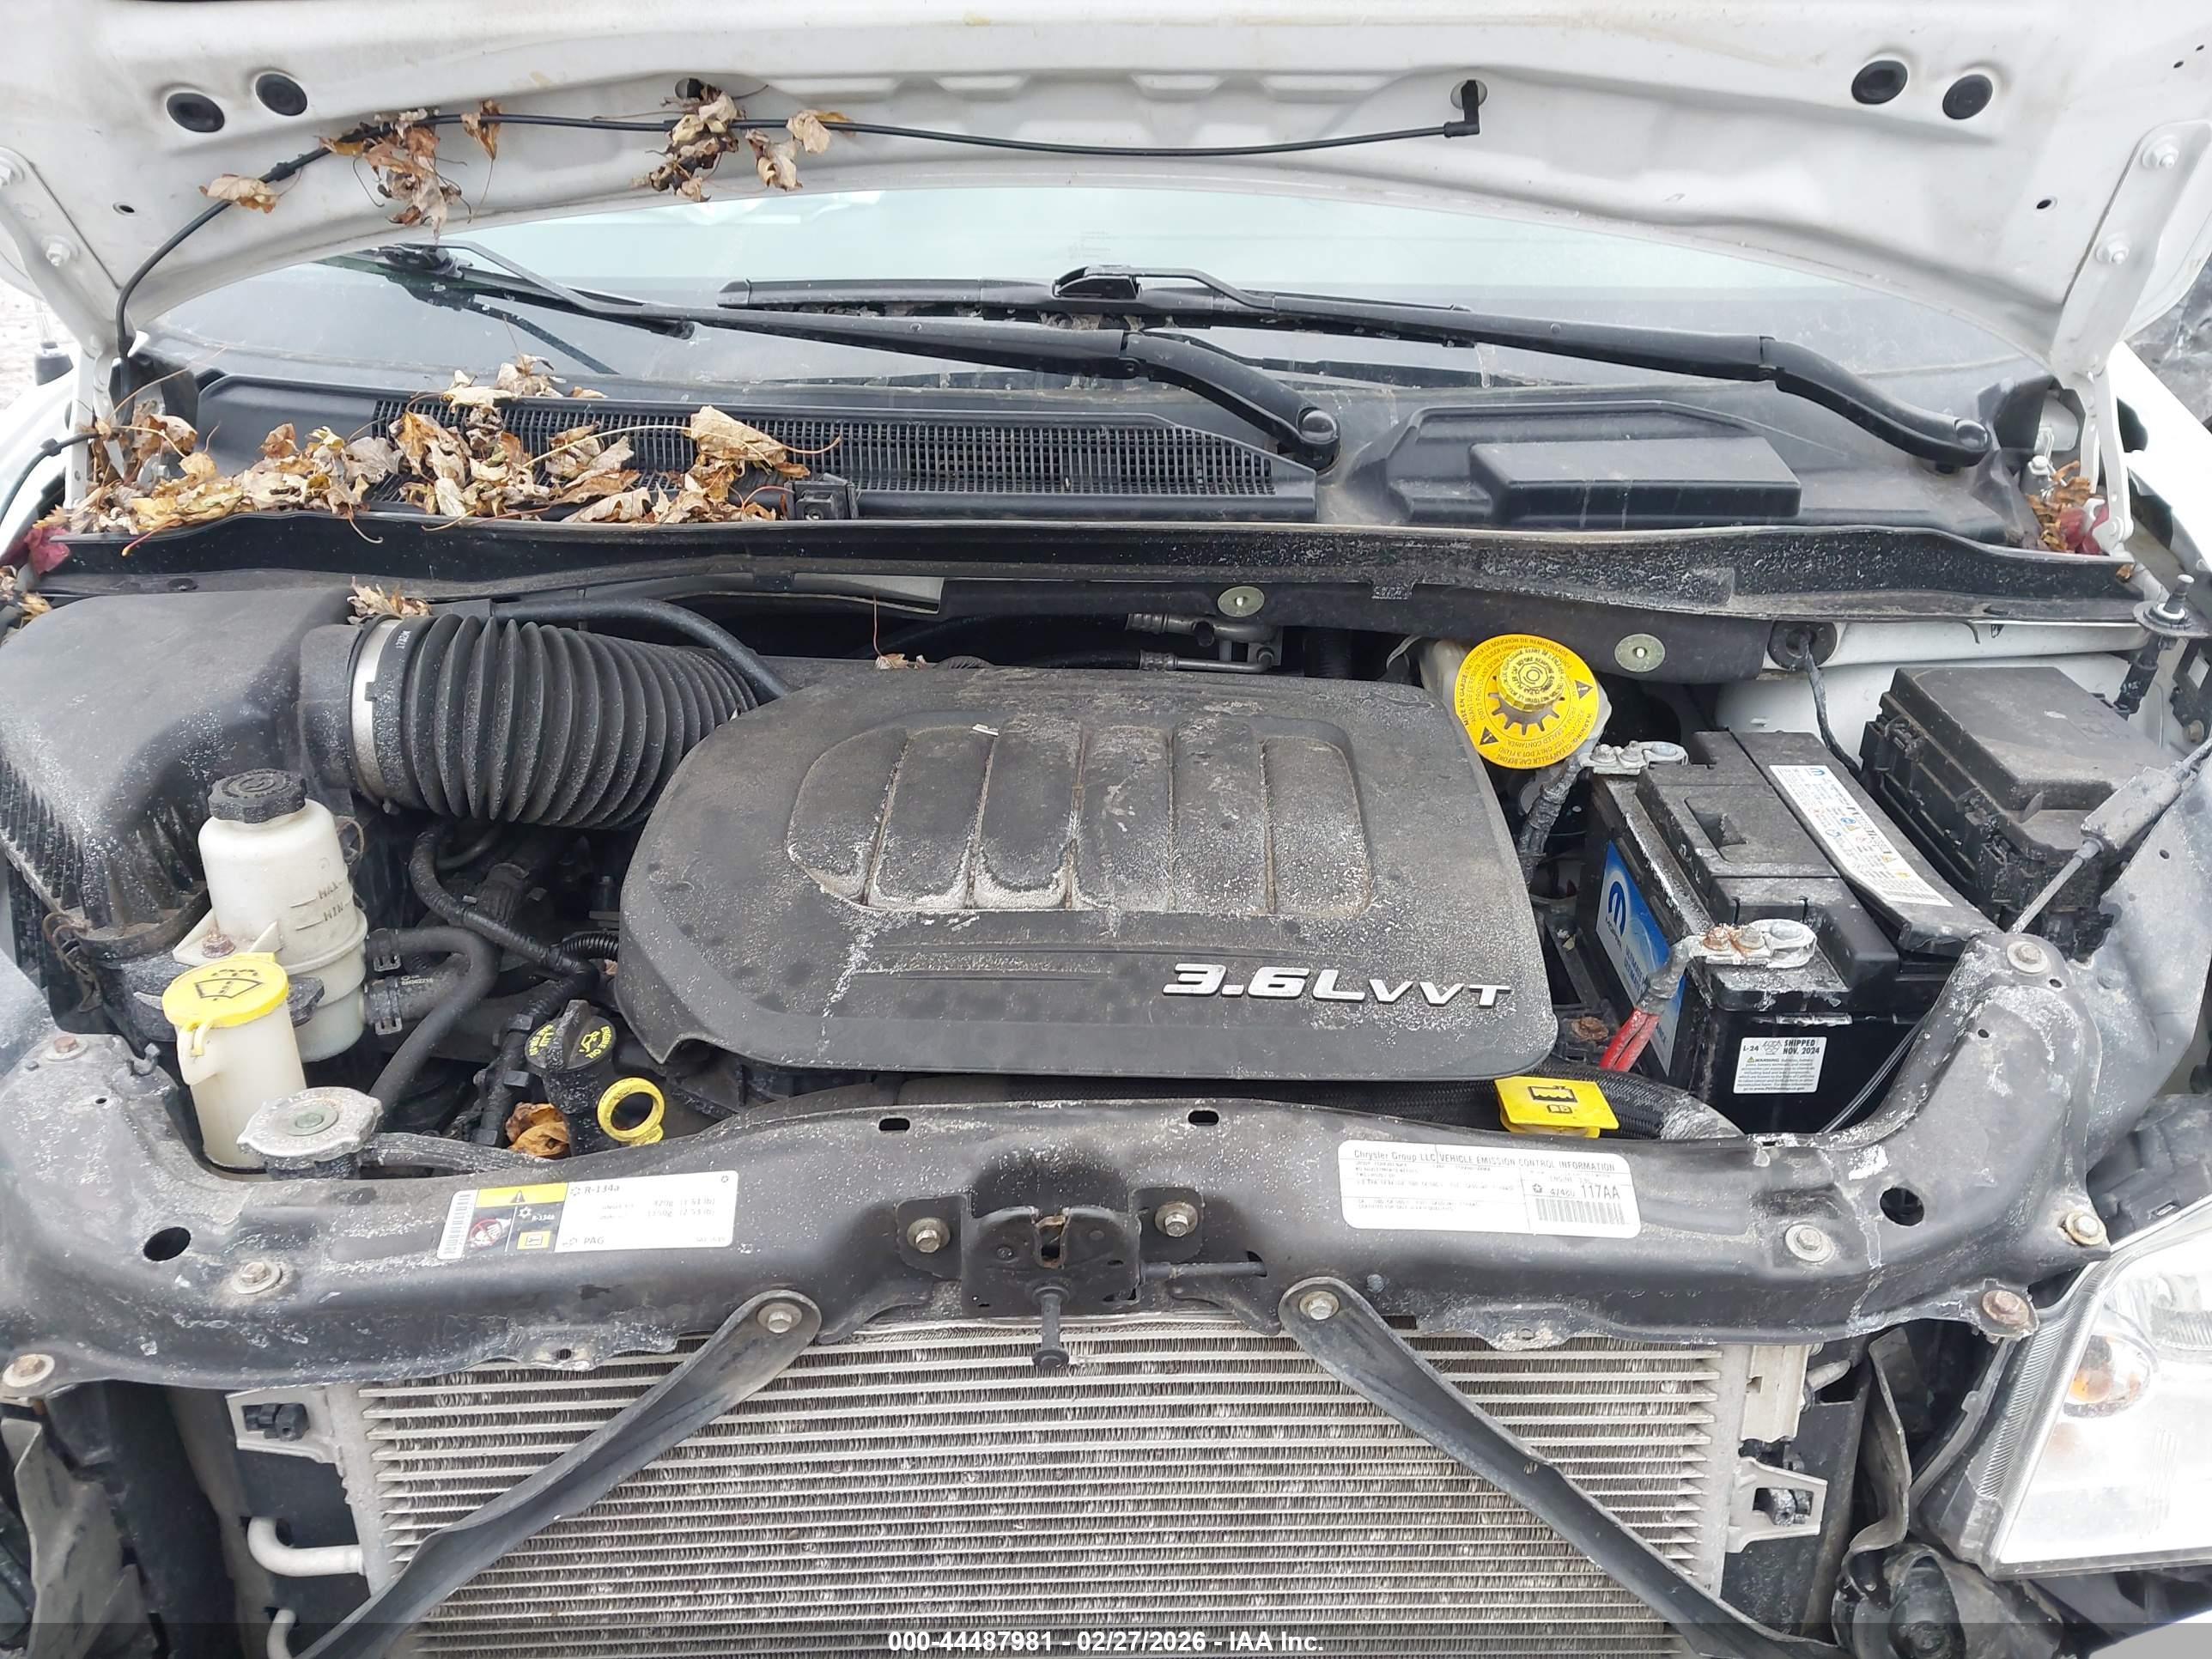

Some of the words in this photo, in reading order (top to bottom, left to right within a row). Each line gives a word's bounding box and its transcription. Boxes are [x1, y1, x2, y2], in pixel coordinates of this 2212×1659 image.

[1459, 697, 1466, 708] EN
[1459, 707, 1470, 727] MISE
[324, 902, 343, 921] MIN
[1163, 963, 1366, 1001] 3.6L
[1370, 978, 1514, 1009] VVT
[598, 1026, 612, 1049] ENGINE
[585, 1048, 602, 1059] OIL
[1782, 1047, 1799, 1055] NOV.
[1354, 1150, 1389, 1161] Chrysler
[1391, 1152, 1417, 1163] Group
[1420, 1153, 1437, 1162] LLC
[1439, 1153, 1473, 1164] VEHICLE
[1476, 1155, 1516, 1166] EMISSION
[1518, 1158, 1555, 1168] CONTROL
[1559, 1160, 1615, 1171] INFORMATION
[584, 1184, 620, 1194] R-134a
[1580, 1184, 1621, 1200] 117AA
[583, 1237, 605, 1245] PAG
